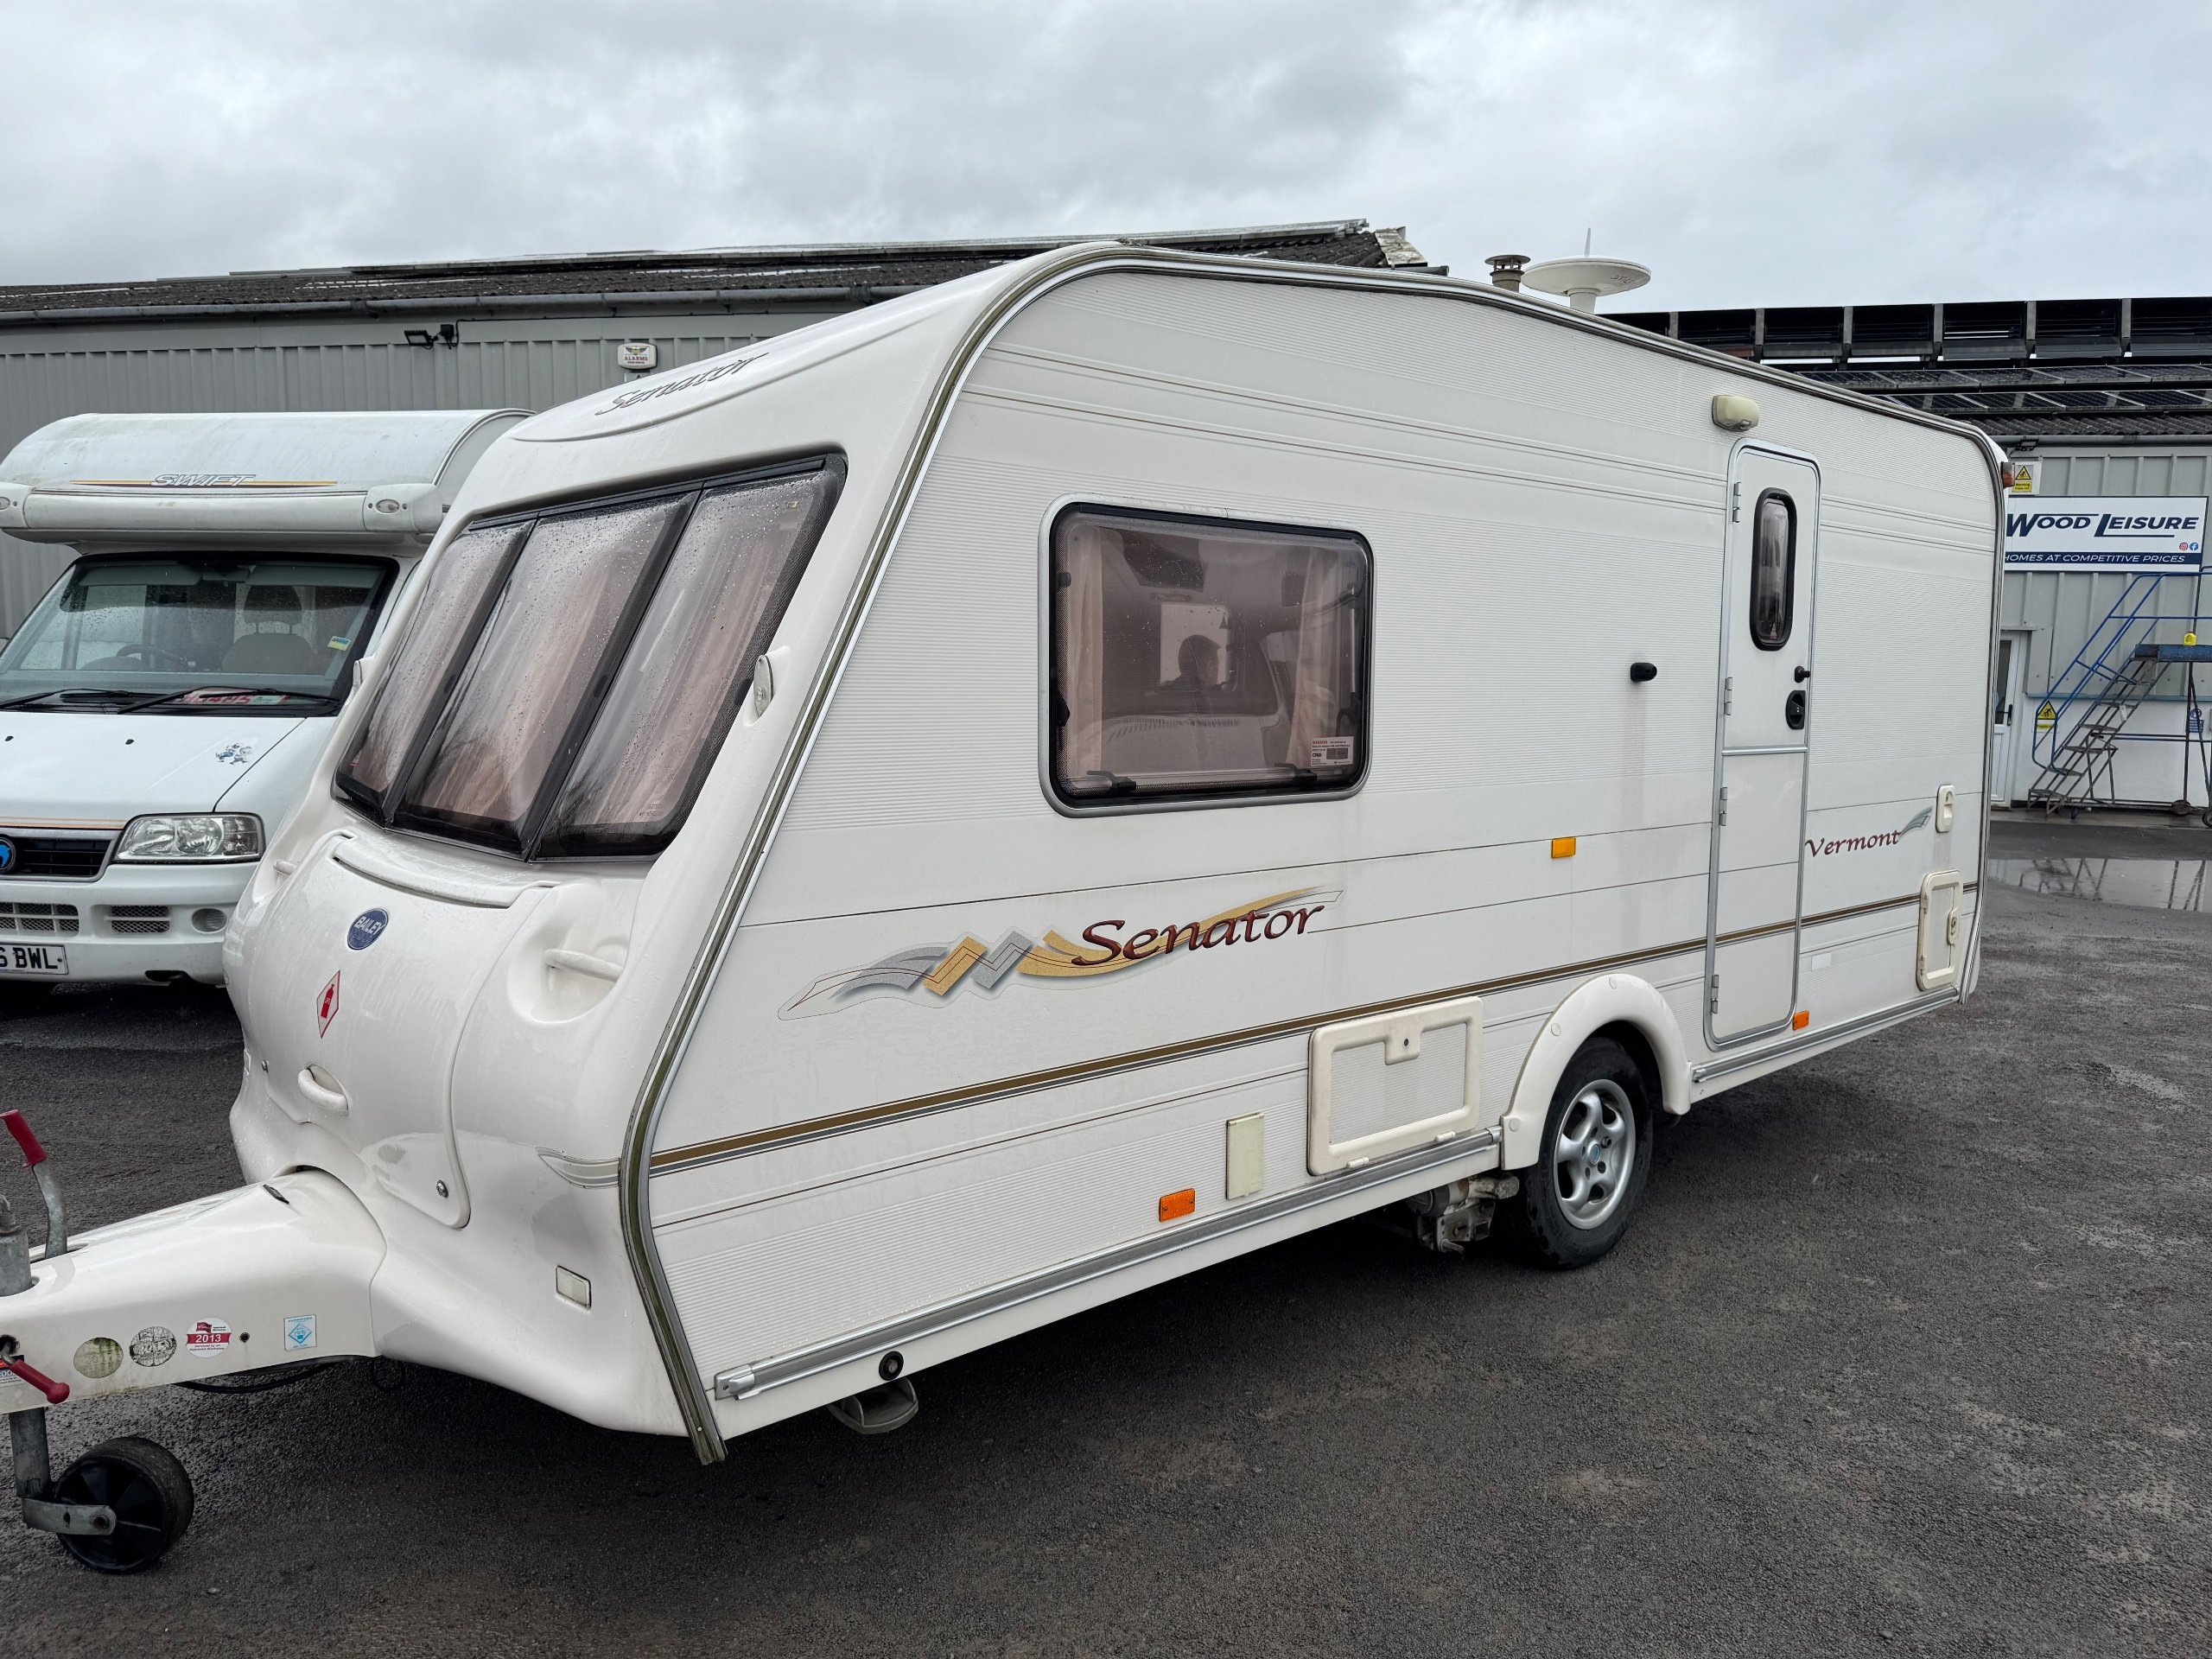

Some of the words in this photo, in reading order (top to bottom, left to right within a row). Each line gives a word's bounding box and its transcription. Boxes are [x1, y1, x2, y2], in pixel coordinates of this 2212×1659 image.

[594, 353, 769, 416] Senator
[150, 474, 256, 486] SWIFT
[2005, 513, 2099, 537] WOOD
[2094, 513, 2199, 537] LEISURE
[2063, 554, 2139, 563] COMPETITIVE
[1805, 830, 1902, 857] Vermont
[353, 916, 386, 936] BAILEY
[1071, 905, 1325, 966] Senator
[13, 947, 58, 969] BWL
[195, 1334, 221, 1343] 2013
